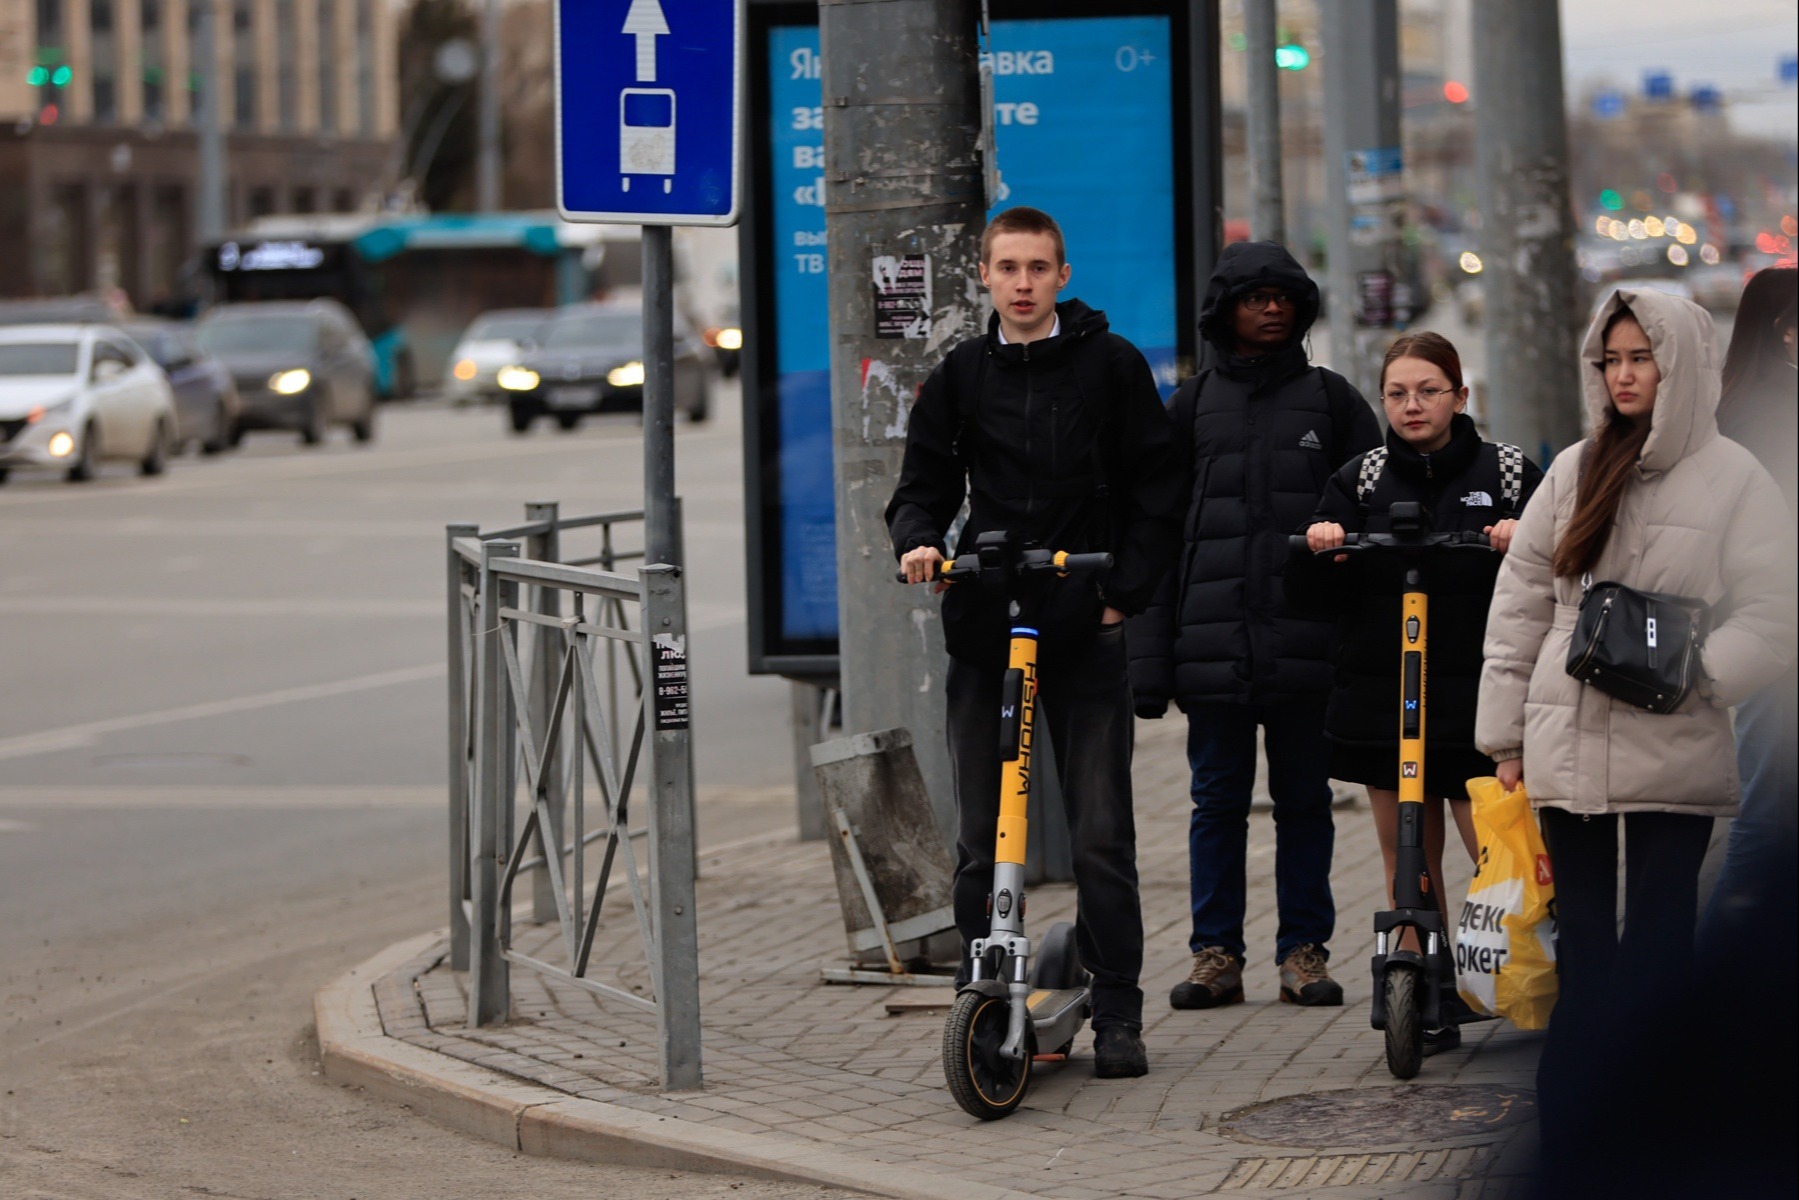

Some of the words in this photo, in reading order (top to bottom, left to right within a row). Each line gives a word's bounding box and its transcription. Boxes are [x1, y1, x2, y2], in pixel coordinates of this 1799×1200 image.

[793, 253, 825, 273] ТВ
[1001, 704, 1014, 719] W
[1405, 699, 1417, 710] W
[1016, 661, 1037, 796] WHOOSH
[1403, 763, 1417, 776] W
